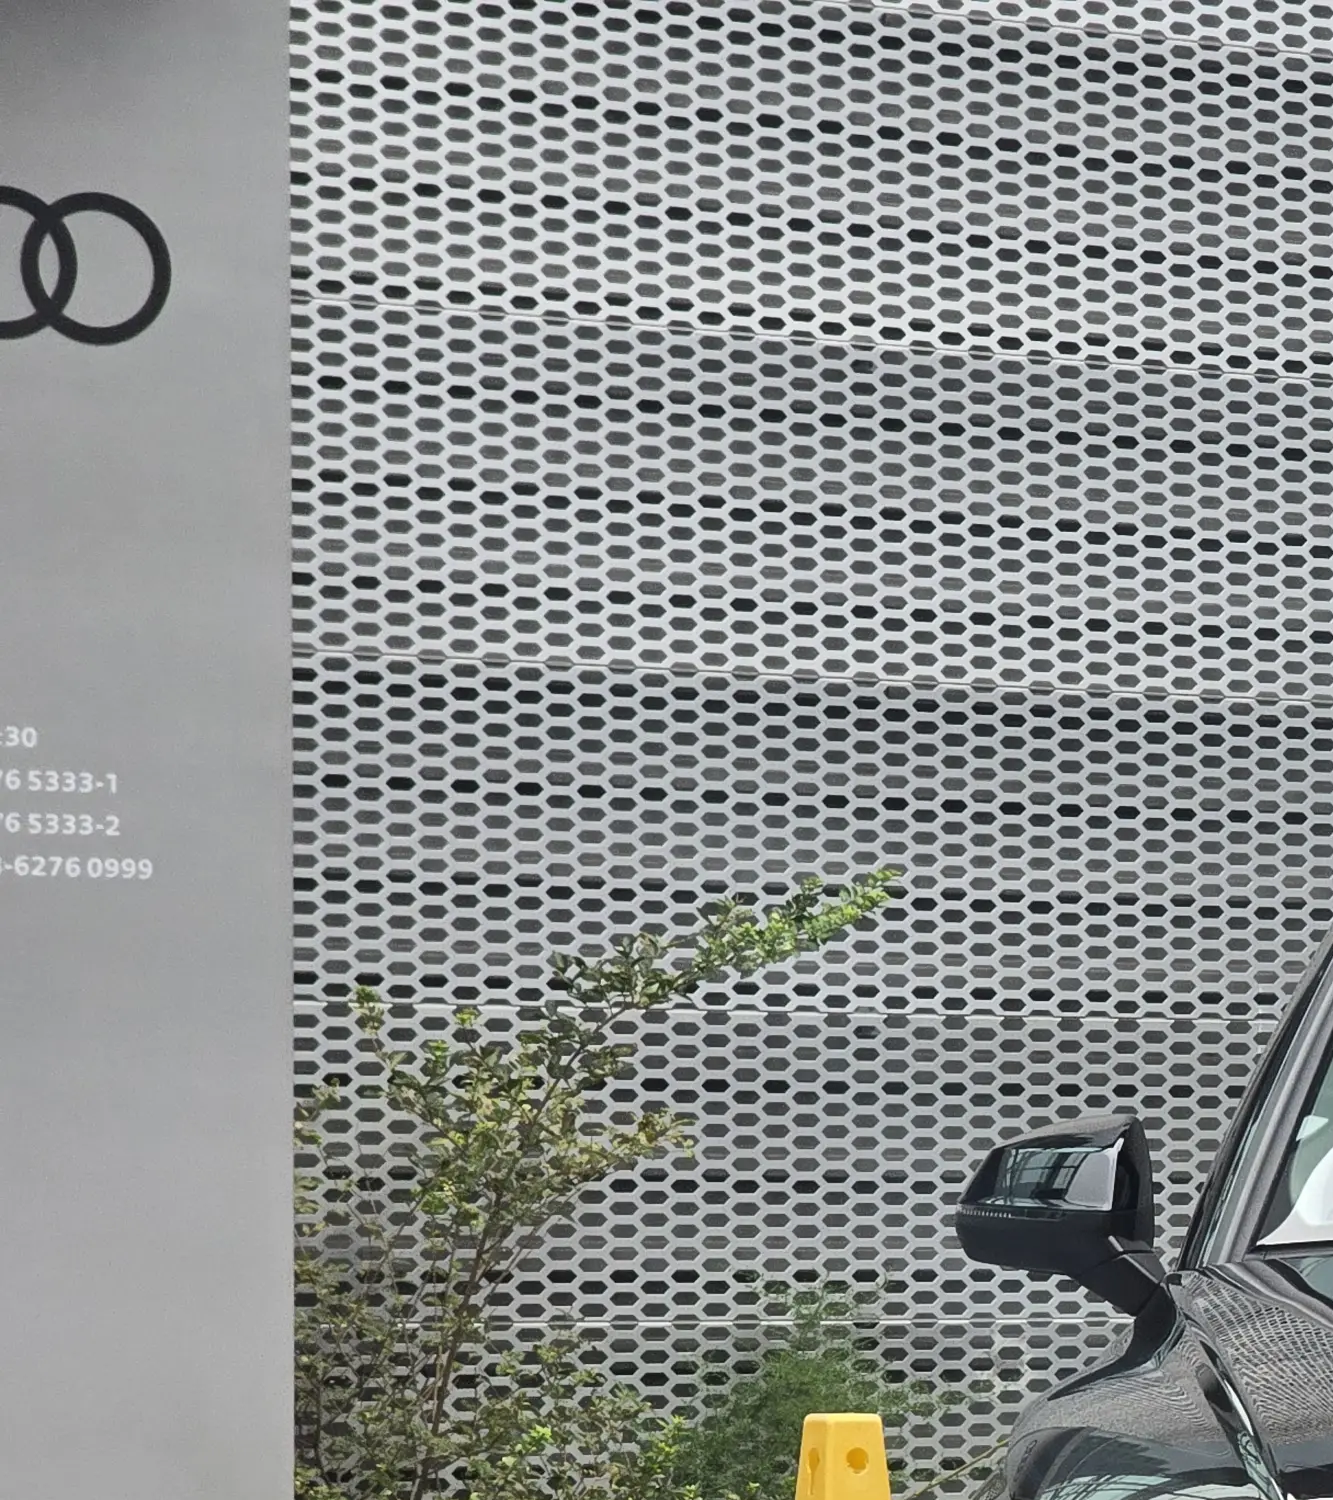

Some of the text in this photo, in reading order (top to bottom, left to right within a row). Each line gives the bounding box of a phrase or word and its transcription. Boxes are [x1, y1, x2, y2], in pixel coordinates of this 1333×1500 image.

[0, 769, 118, 794] 6 5333-1
[0, 812, 121, 836] 6 5333-2
[0, 855, 153, 880] -6276 0999
